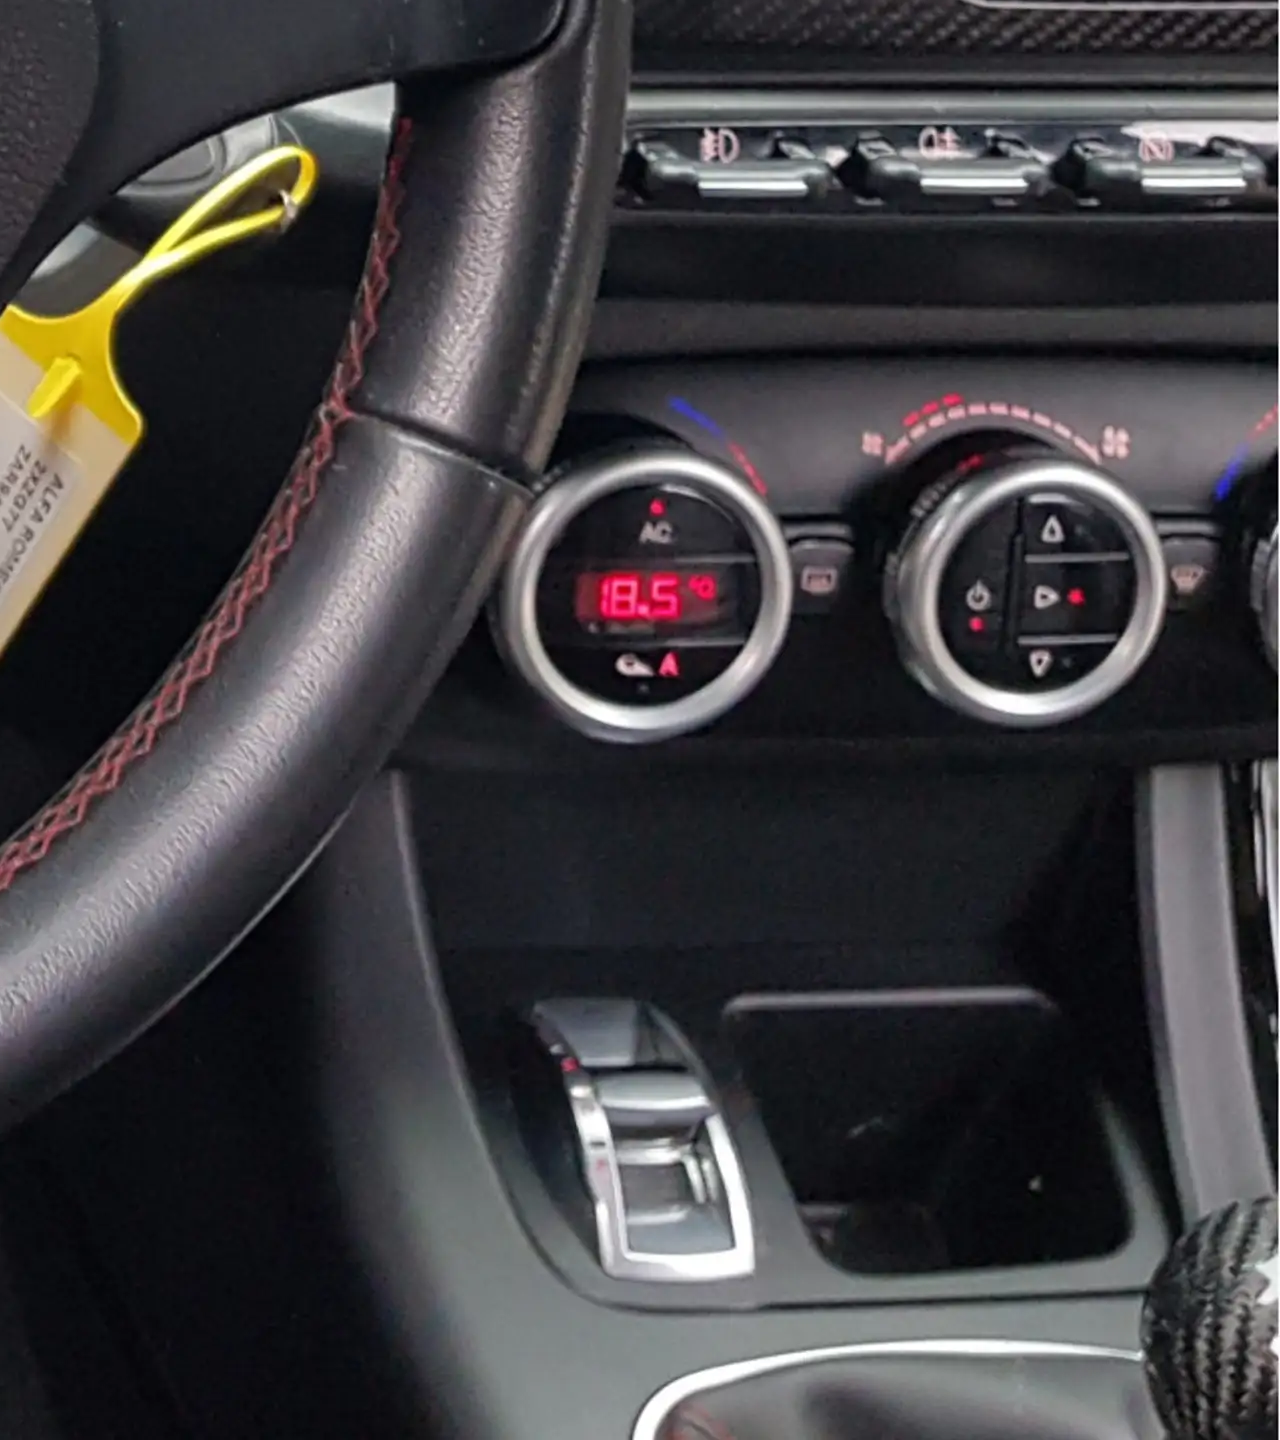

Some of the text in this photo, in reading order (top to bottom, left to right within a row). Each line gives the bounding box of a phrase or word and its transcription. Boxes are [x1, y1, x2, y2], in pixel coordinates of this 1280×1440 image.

[30, 473, 65, 524] ALFA
[639, 520, 673, 544] AC
[601, 574, 680, 619] 18.5
